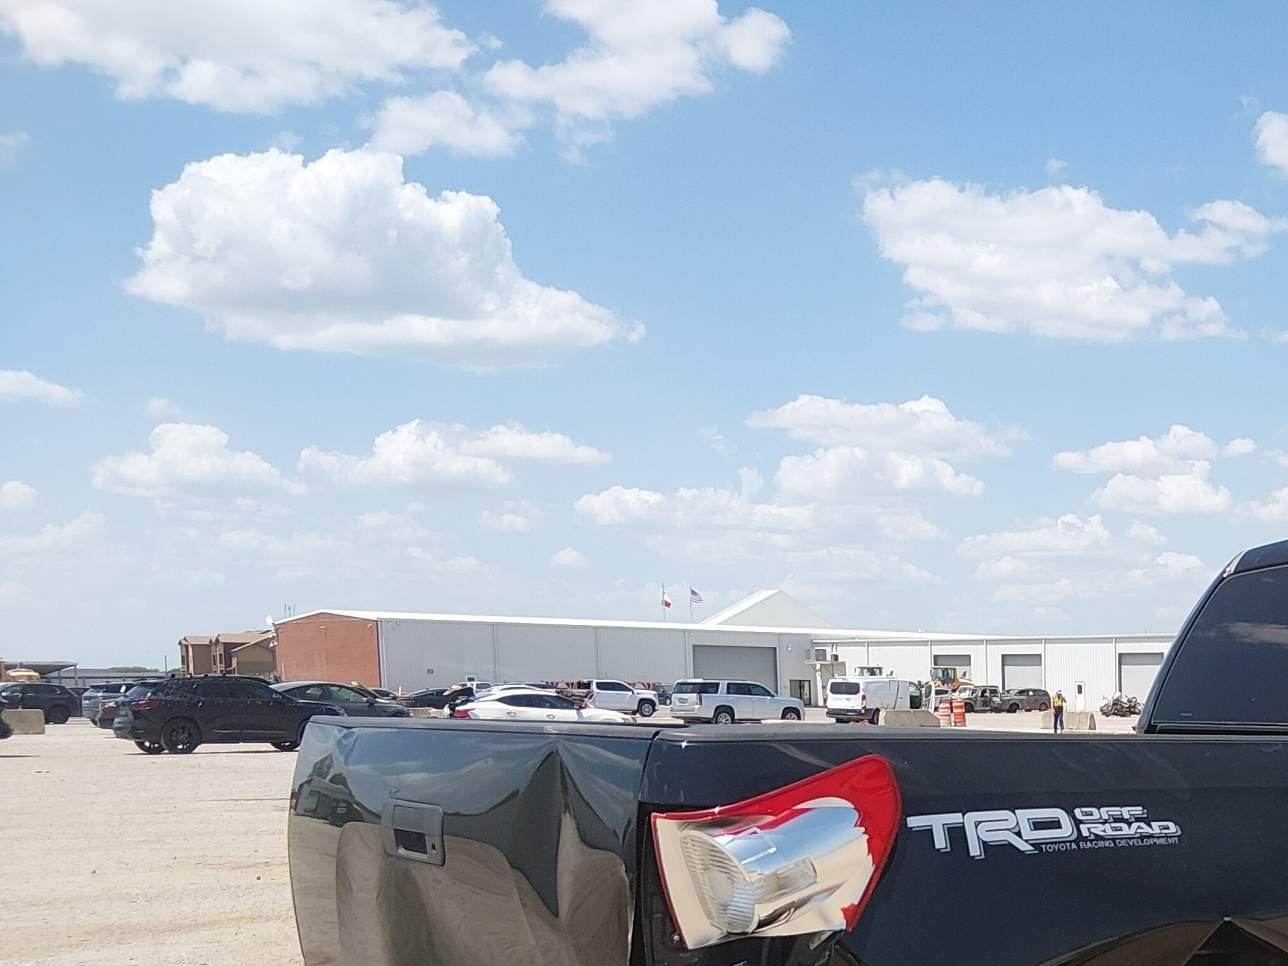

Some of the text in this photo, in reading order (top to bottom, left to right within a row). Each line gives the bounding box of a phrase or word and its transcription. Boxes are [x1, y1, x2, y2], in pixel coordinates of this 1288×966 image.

[1073, 806, 1147, 822] OFF
[906, 807, 1078, 859] TRD
[1079, 821, 1182, 840] ROAD
[1041, 837, 1179, 853] TOYOTA RACING DEVELOPMENT
